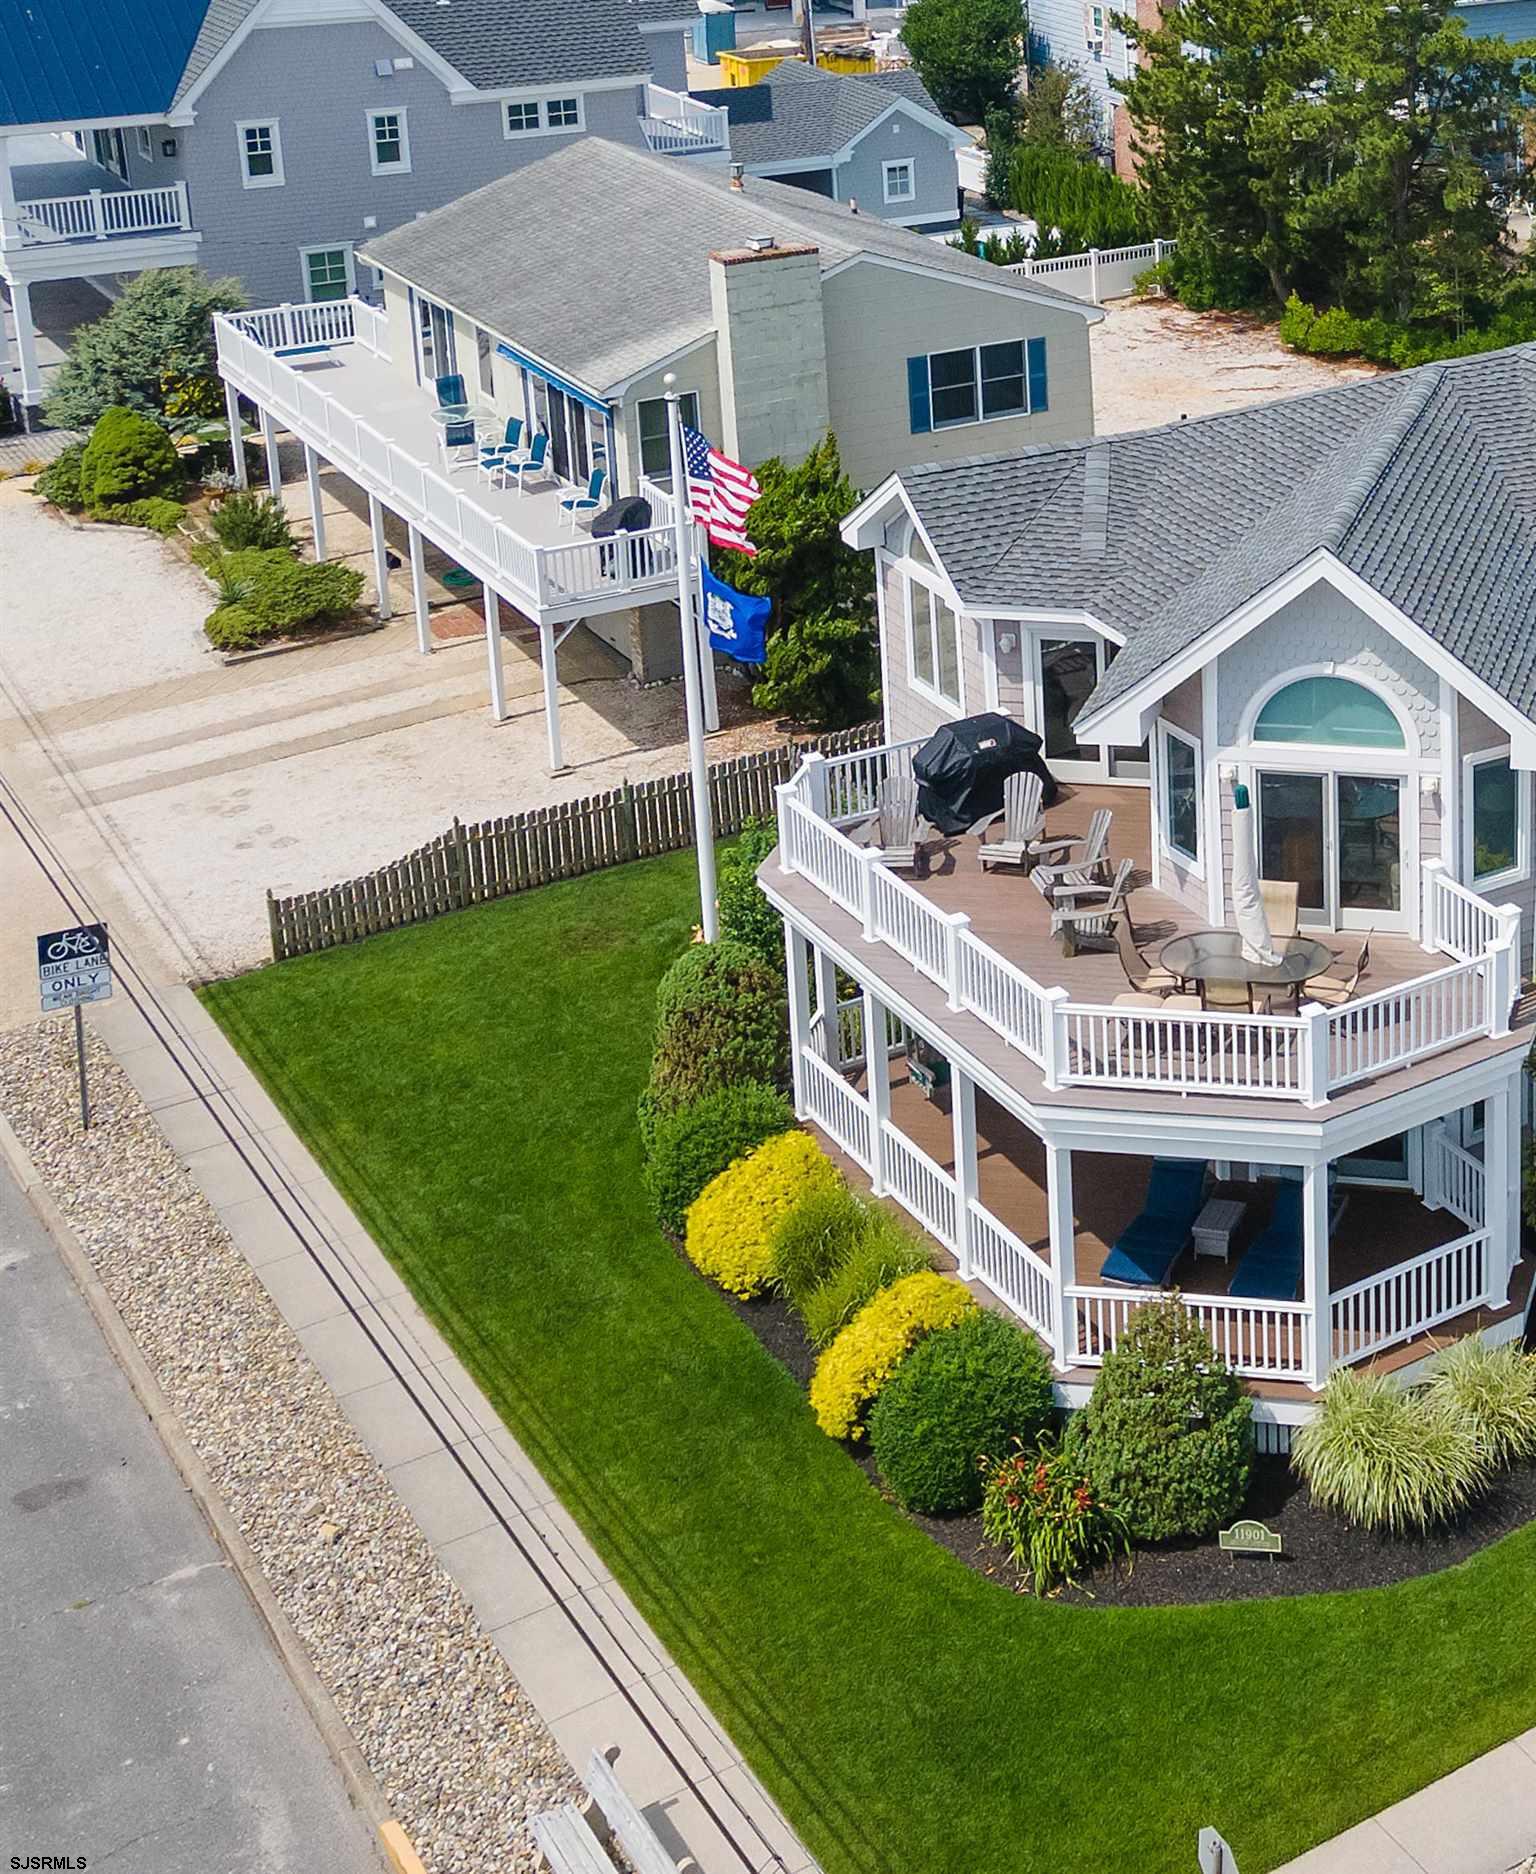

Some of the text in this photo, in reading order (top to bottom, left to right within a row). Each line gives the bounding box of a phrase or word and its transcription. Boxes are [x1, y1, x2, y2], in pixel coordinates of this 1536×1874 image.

[43, 953, 108, 977] BIKE LANE
[51, 972, 99, 992] ONLY
[1234, 1528, 1265, 1541] 11901
